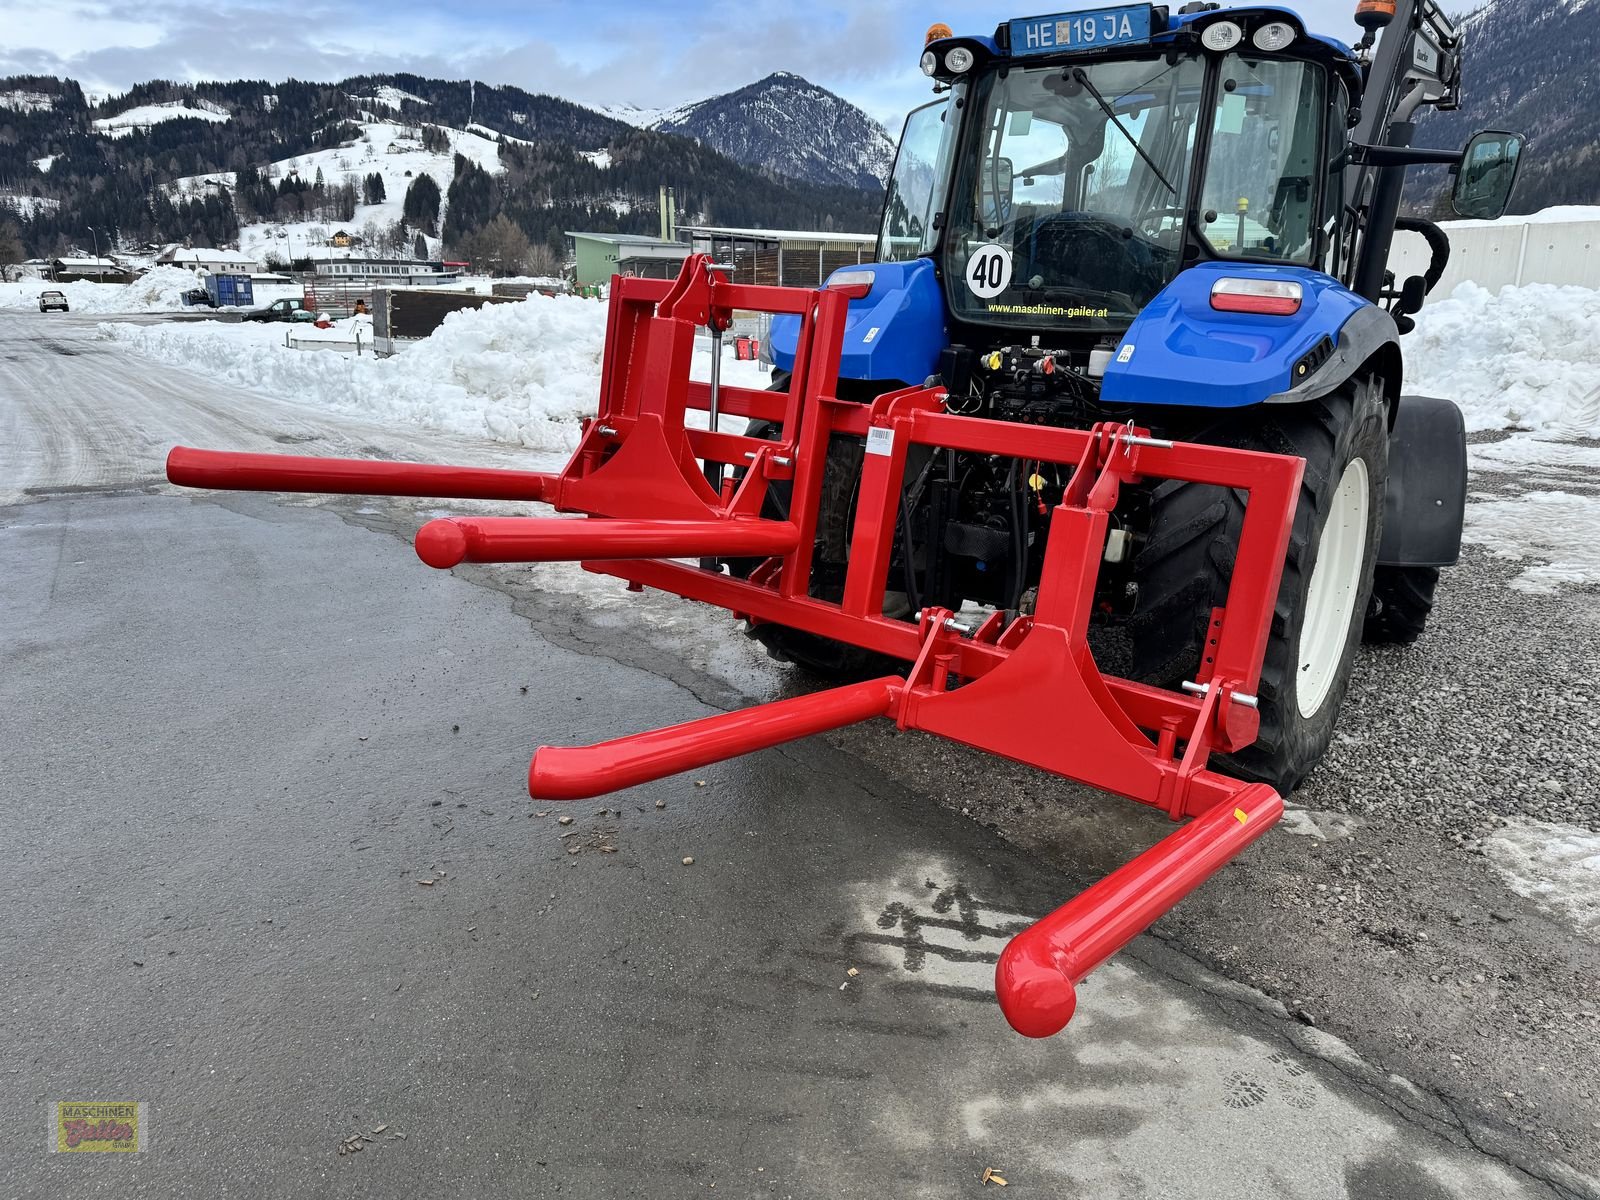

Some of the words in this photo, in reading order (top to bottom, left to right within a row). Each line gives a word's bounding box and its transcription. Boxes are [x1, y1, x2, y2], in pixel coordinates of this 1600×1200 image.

[1026, 23, 1053, 48] HE
[1073, 17, 1096, 43] 19
[1103, 13, 1133, 40] JA
[972, 254, 1004, 289] 40
[988, 303, 1108, 318] www.maschinen-gailer.at
